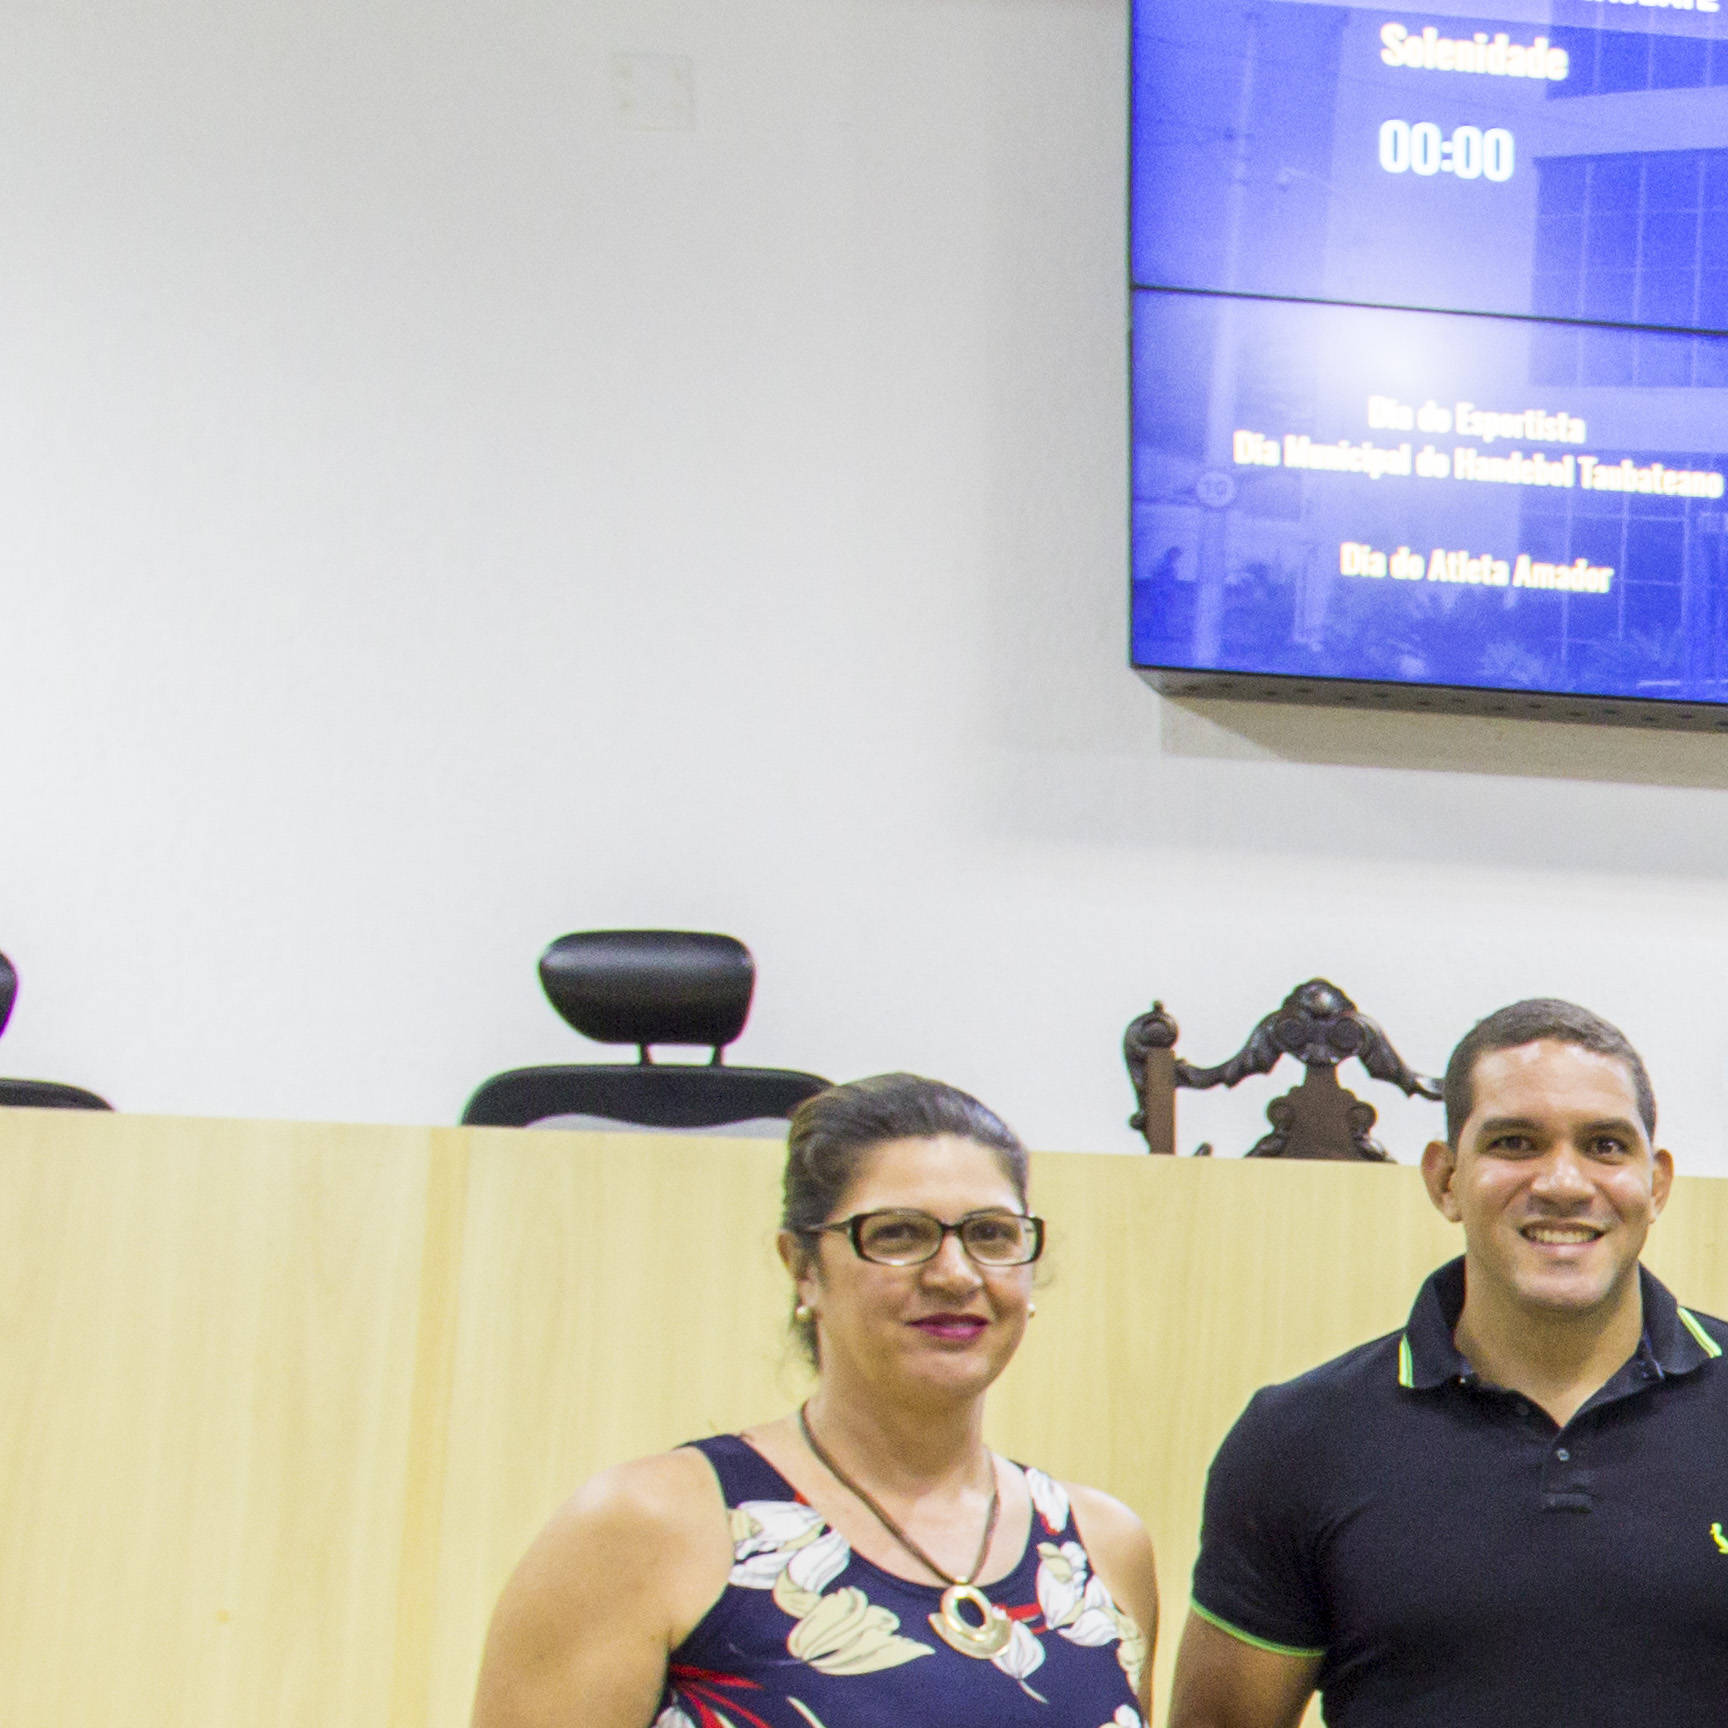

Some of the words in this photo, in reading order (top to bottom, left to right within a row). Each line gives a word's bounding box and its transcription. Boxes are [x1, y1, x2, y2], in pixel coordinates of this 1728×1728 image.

[1380, 23, 1569, 81] Solenidade
[1379, 119, 1514, 182] 00:00
[1368, 395, 1413, 431] Dia
[1417, 400, 1450, 433] do
[1455, 402, 1586, 444] Esportista
[1233, 430, 1281, 467] Dia
[1283, 434, 1412, 479] Municipal
[1415, 445, 1450, 479] do
[1453, 447, 1575, 488] Handebol
[1577, 455, 1725, 498] Taubateano
[1340, 542, 1387, 578] Dia
[1389, 546, 1425, 581] do
[1427, 548, 1510, 587] Atleta
[1512, 554, 1614, 593] Amador
